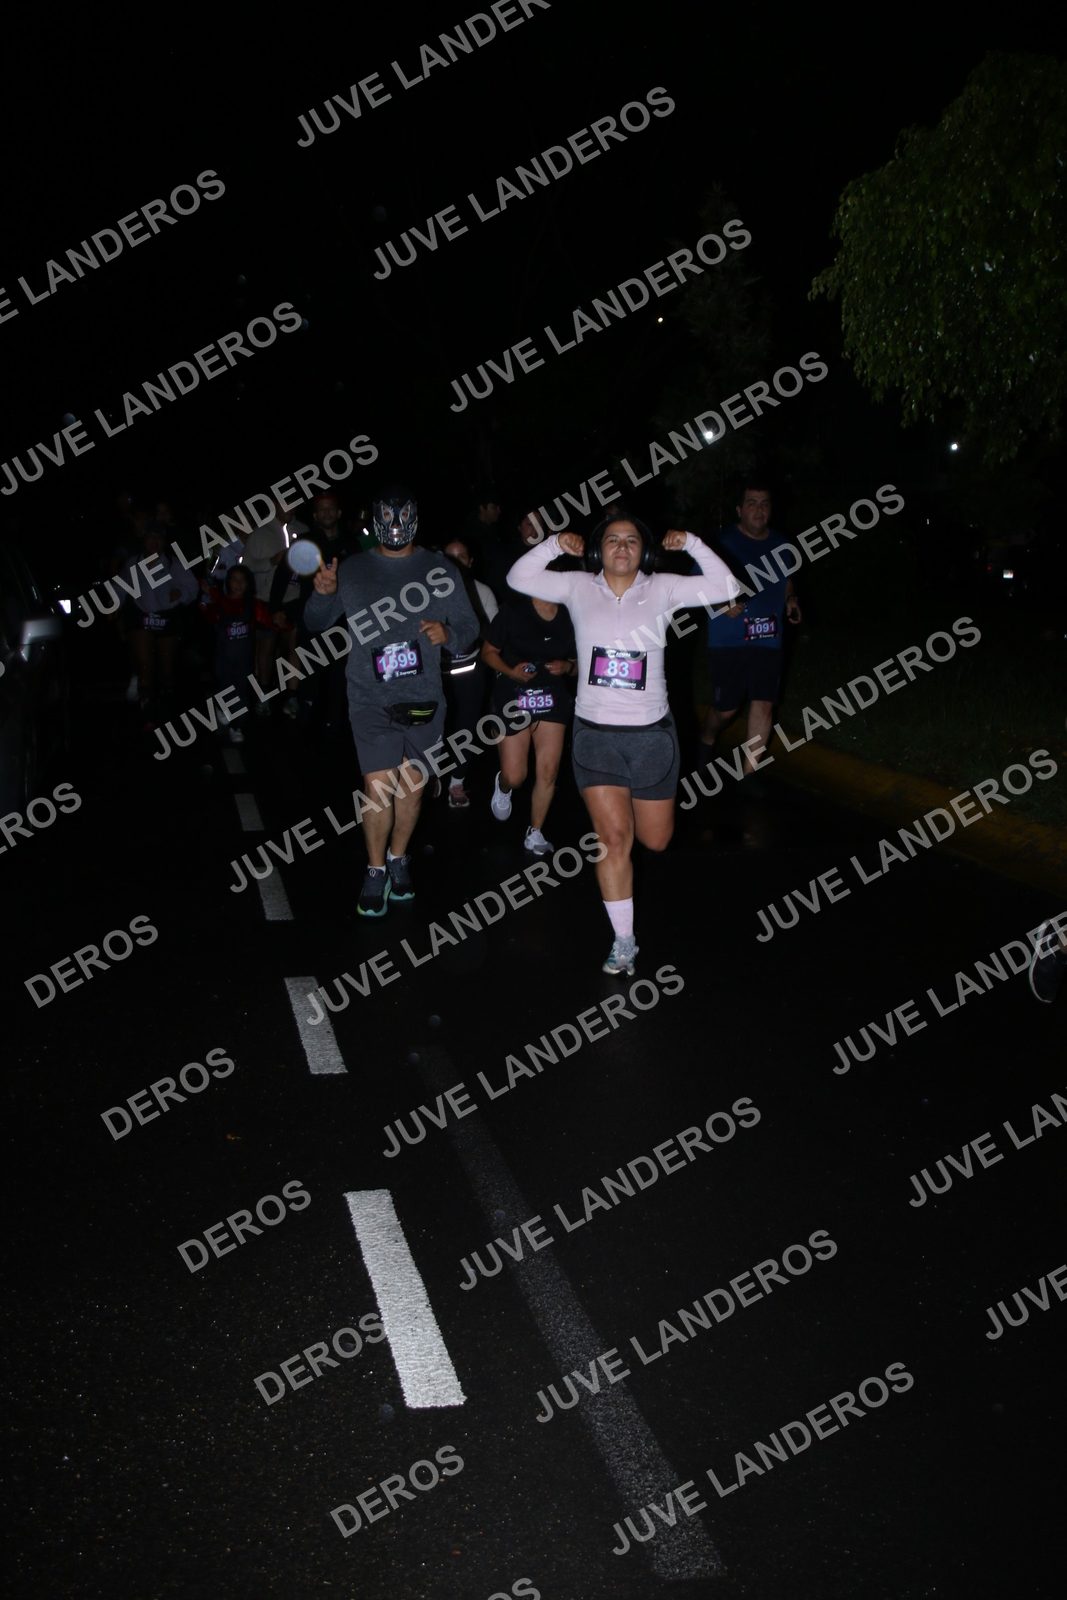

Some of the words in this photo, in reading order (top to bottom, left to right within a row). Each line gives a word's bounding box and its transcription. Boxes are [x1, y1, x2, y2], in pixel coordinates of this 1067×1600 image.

[749, 621, 775, 635] 1091
[607, 660, 629, 678] 83
[520, 694, 554, 708] 1635
